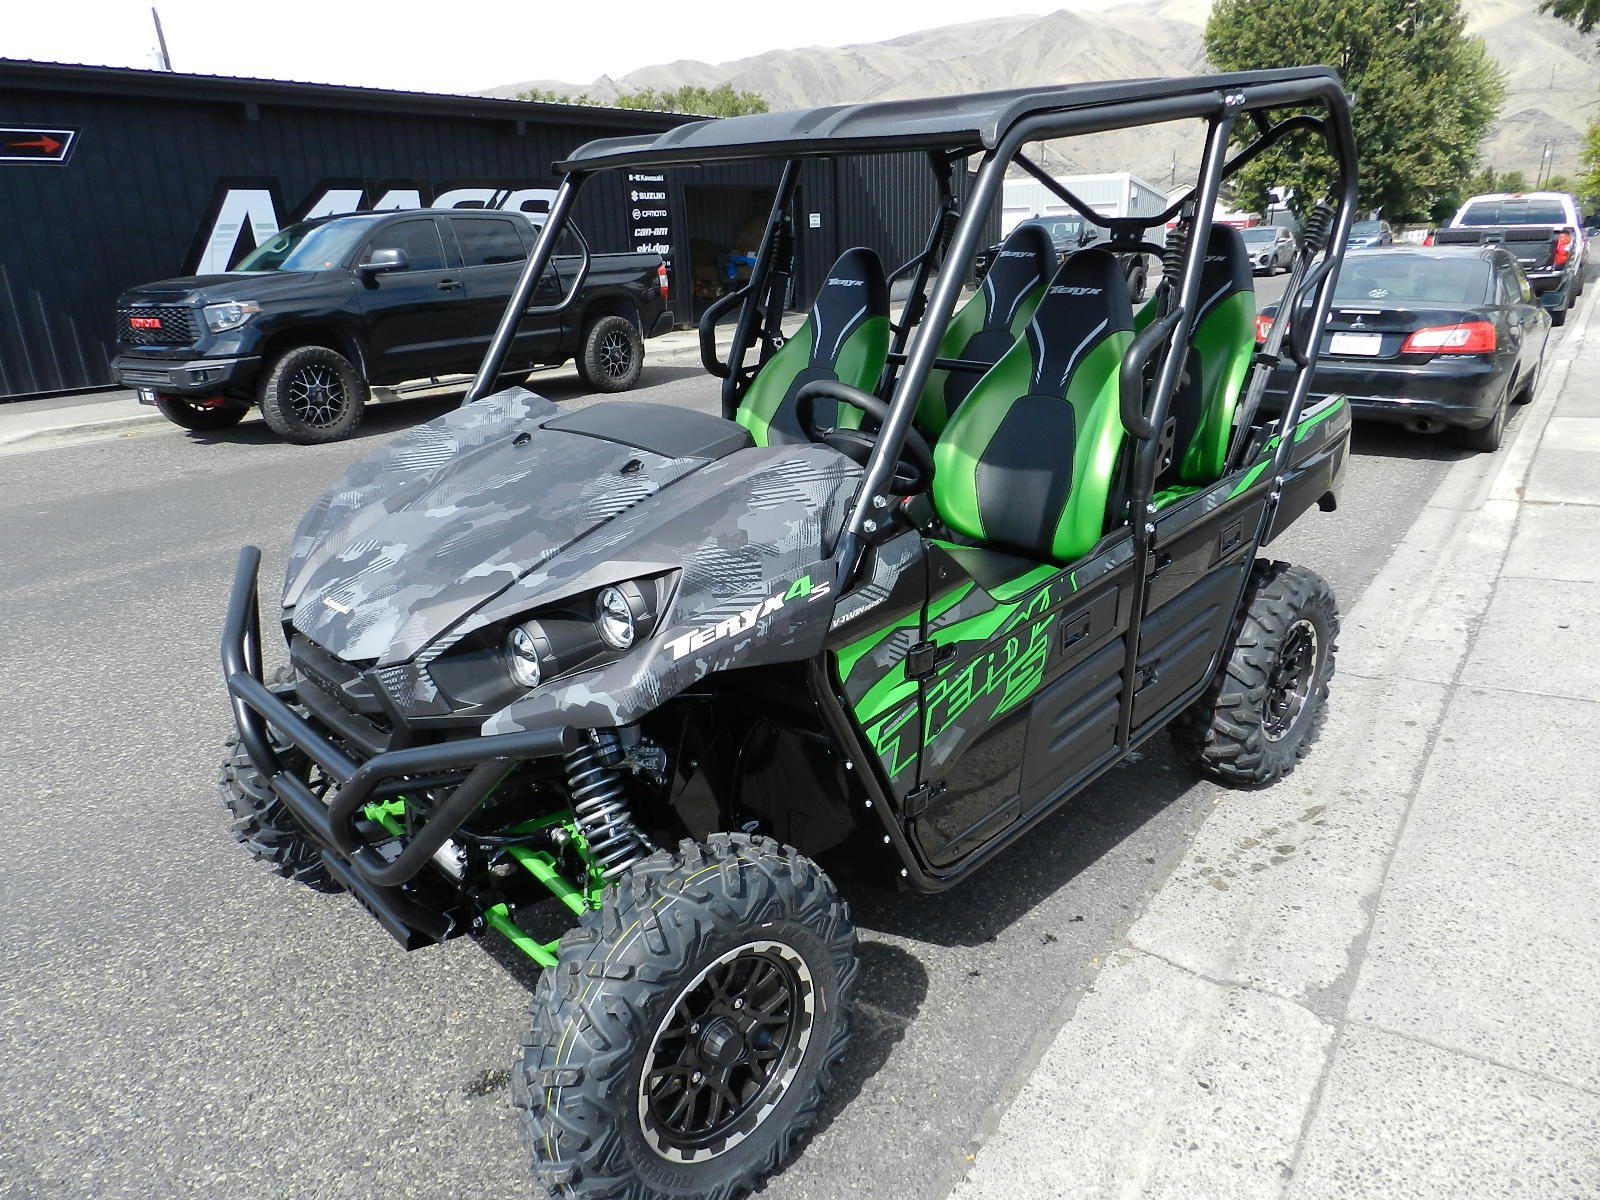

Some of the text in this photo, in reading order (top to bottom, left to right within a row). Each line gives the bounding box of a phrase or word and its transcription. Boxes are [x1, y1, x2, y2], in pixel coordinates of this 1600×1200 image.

[639, 192, 666, 200] SUZUKI
[634, 227, 668, 237] can-am
[130, 318, 162, 329] TOYOTA
